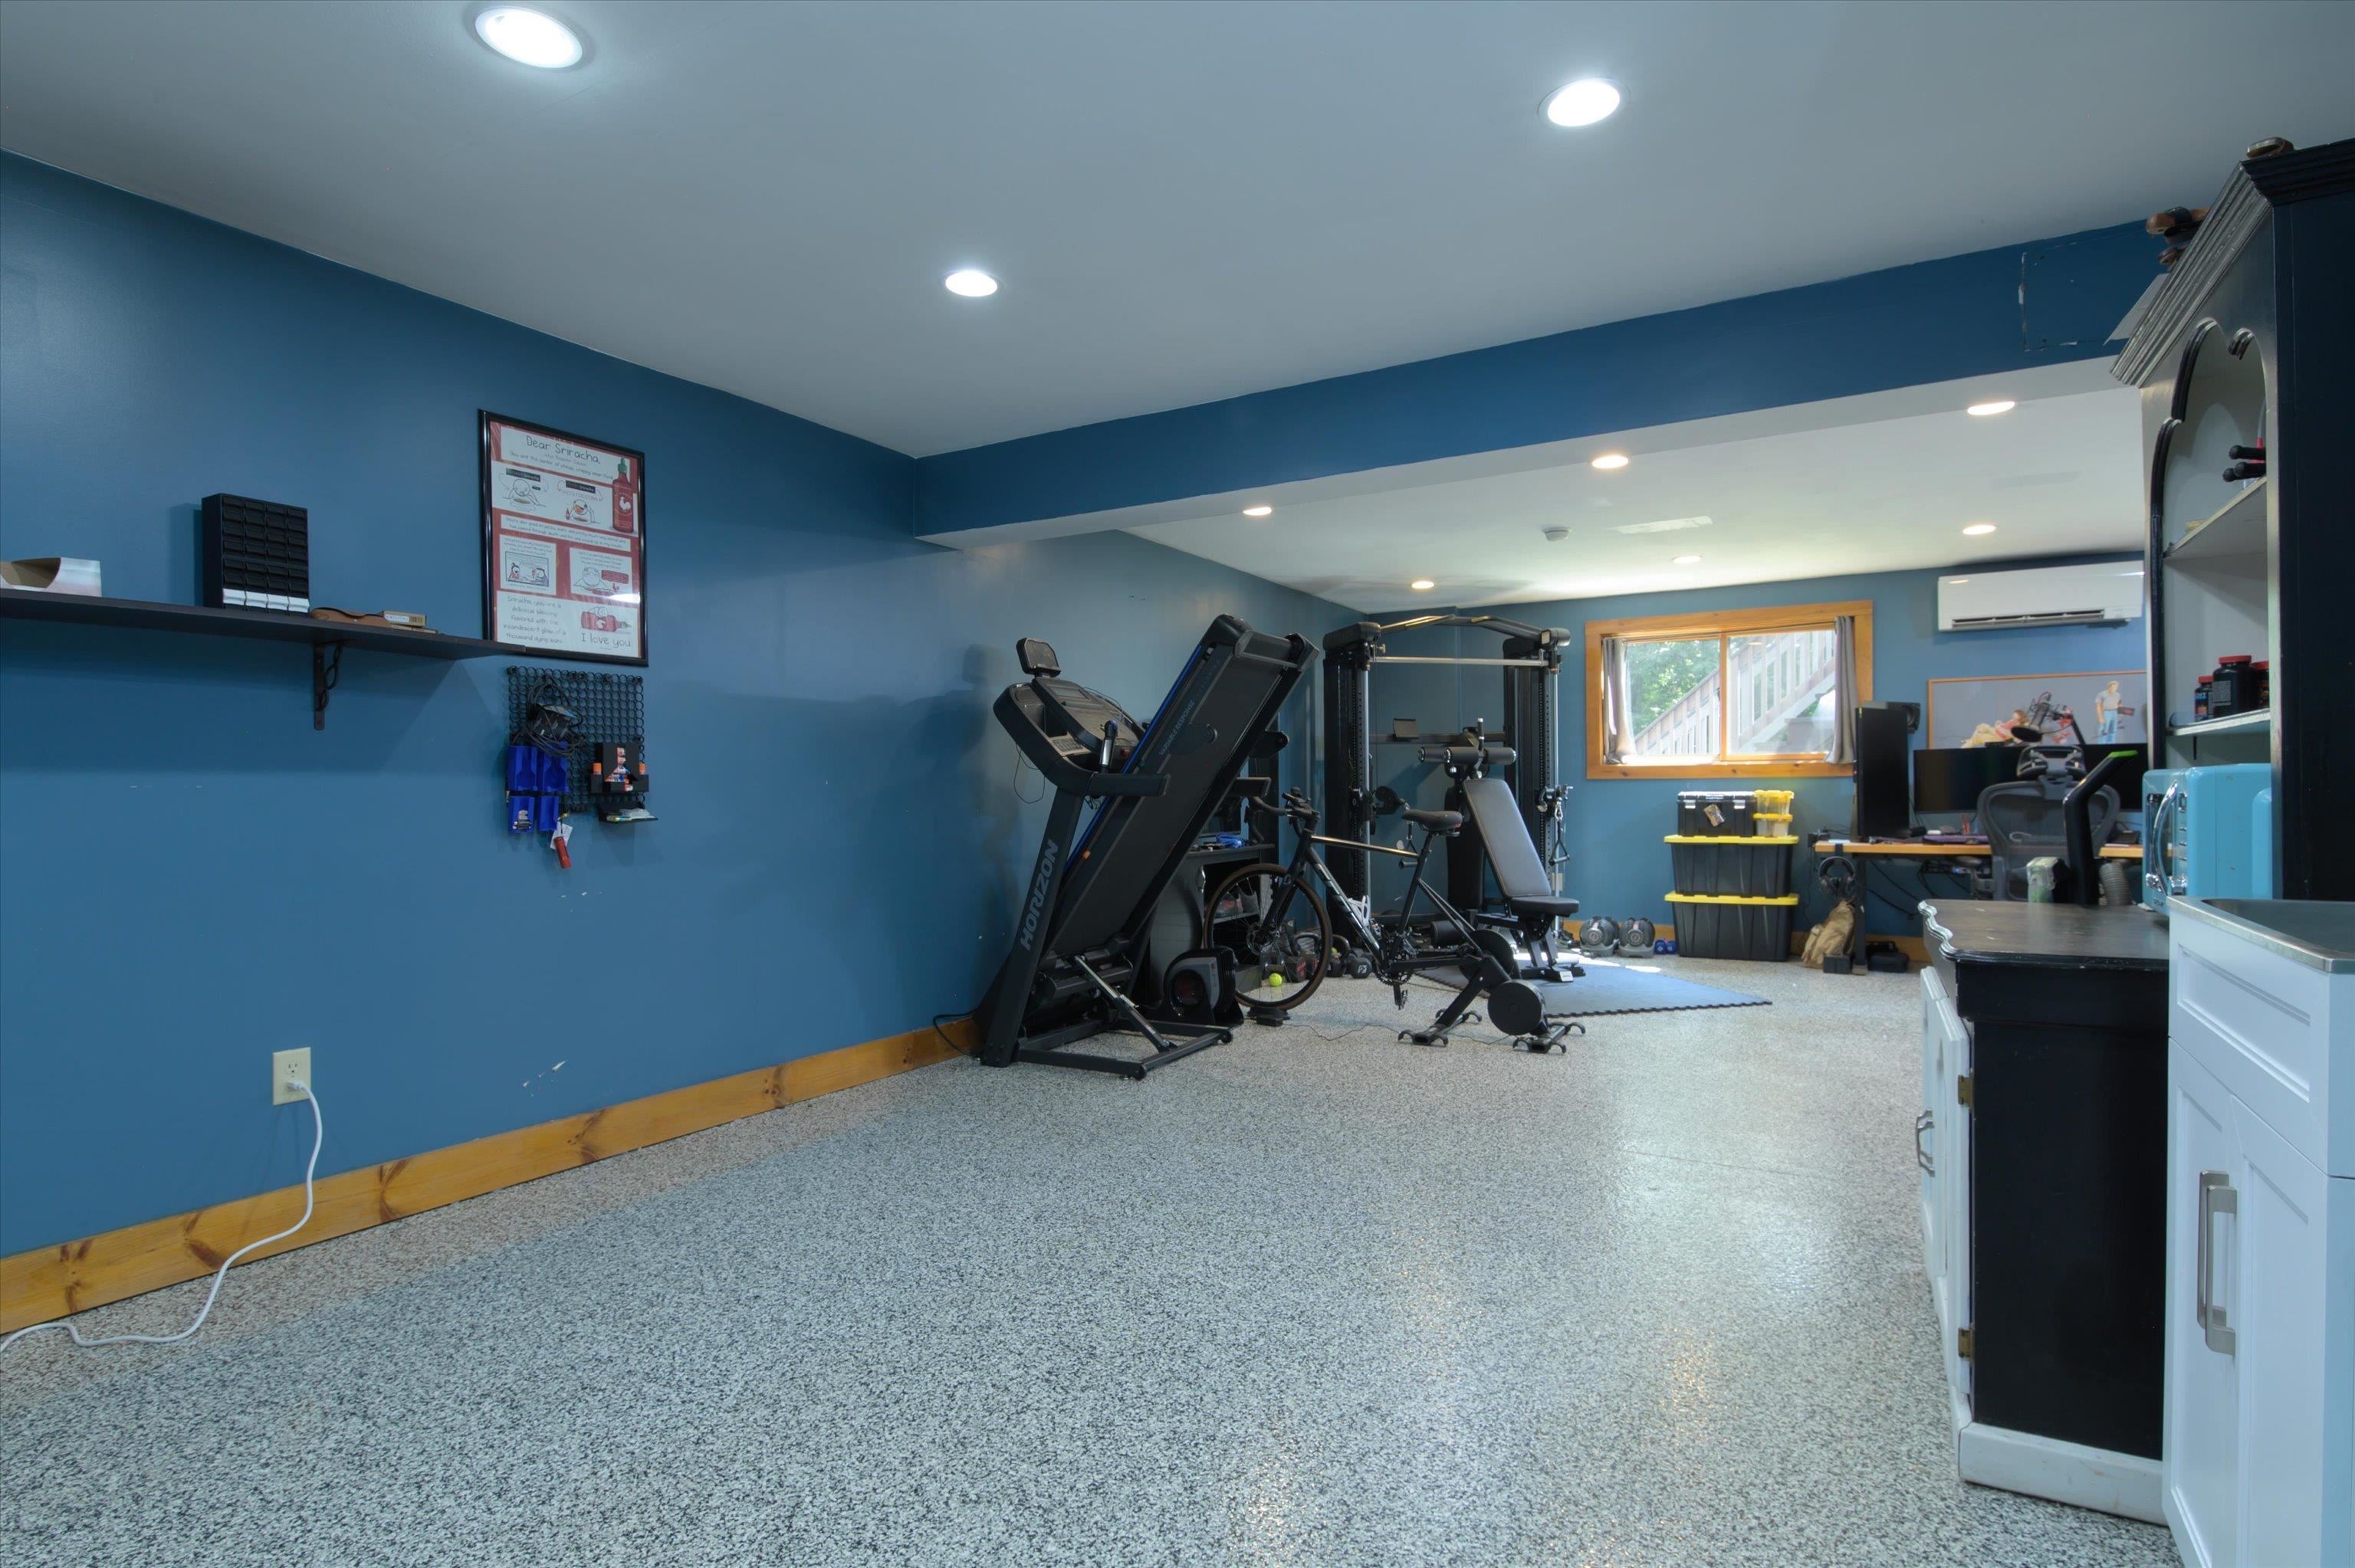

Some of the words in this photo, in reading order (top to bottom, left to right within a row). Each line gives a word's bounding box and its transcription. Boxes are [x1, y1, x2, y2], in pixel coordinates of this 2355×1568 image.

[526, 435, 550, 451] Dear
[581, 632, 586, 641] I
[590, 632, 609, 645] love
[613, 638, 631, 649] you
[1020, 838, 1059, 951] HORIZON
